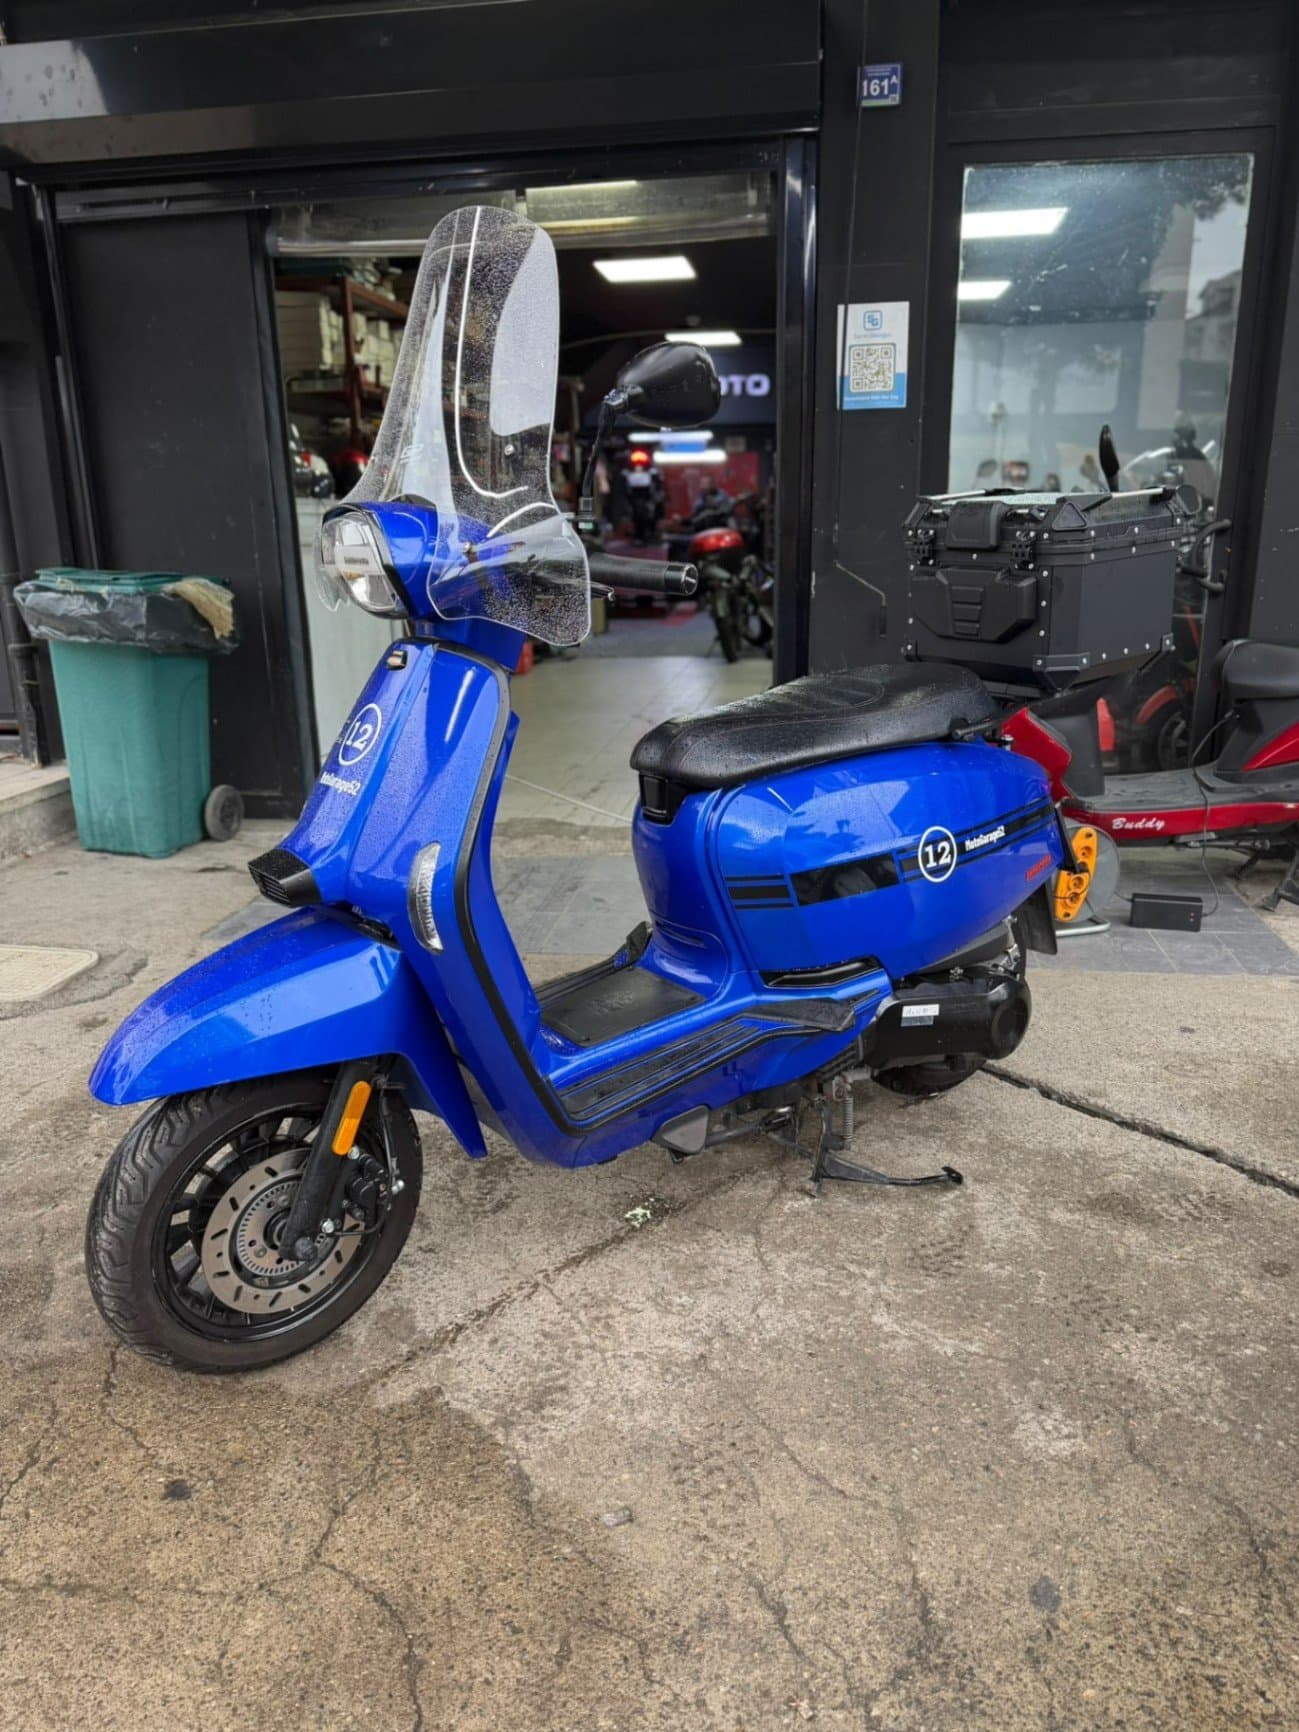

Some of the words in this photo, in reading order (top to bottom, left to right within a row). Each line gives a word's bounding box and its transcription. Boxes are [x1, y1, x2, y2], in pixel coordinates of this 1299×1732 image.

[346, 721, 373, 751] 12
[1112, 817, 1165, 831] Buddy
[925, 841, 951, 868] 12
